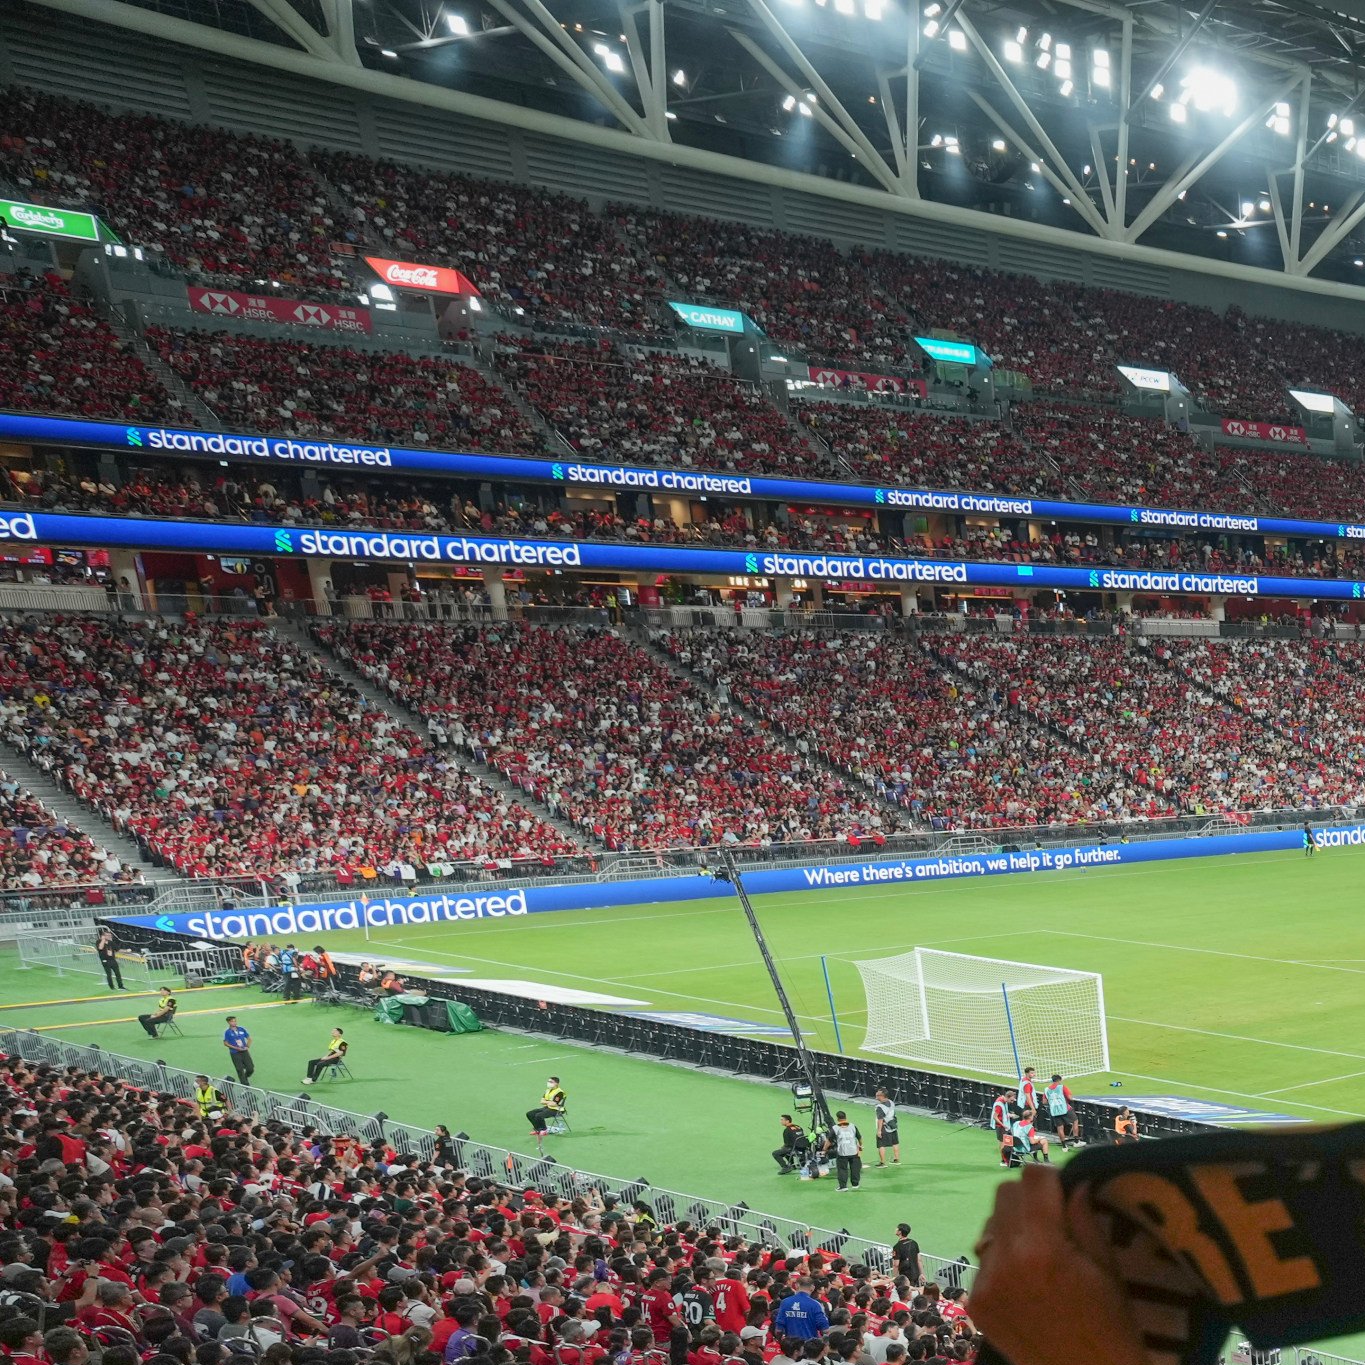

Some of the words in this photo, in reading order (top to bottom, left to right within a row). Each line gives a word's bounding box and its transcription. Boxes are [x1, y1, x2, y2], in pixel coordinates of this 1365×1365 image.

[243, 307, 275, 319] HSBC
[334, 318, 363, 330] HSBC
[691, 312, 735, 328] CATHAY
[149, 429, 268, 456] standard
[275, 438, 392, 466] chartered
[568, 464, 662, 487] standard
[668, 471, 751, 494] chartered
[887, 491, 958, 509] standard
[961, 494, 1032, 514] chartered
[1140, 510, 1199, 526] standard
[1200, 514, 1258, 531] chartered
[300, 530, 441, 560] standard
[446, 537, 581, 567] chartered
[764, 554, 864, 579] standard
[868, 557, 967, 582] chartered
[1103, 571, 1179, 591] standard
[1182, 575, 1258, 595] chartered
[803, 864, 860, 886] Where
[862, 860, 912, 882] there's
[915, 857, 986, 881] ambition,
[989, 858, 1007, 872] we
[1009, 852, 1038, 872] help
[1039, 852, 1051, 867] it
[1054, 854, 1071, 870] go
[1074, 847, 1121, 866] further.
[188, 901, 359, 941] standard
[366, 888, 528, 924] chartered
